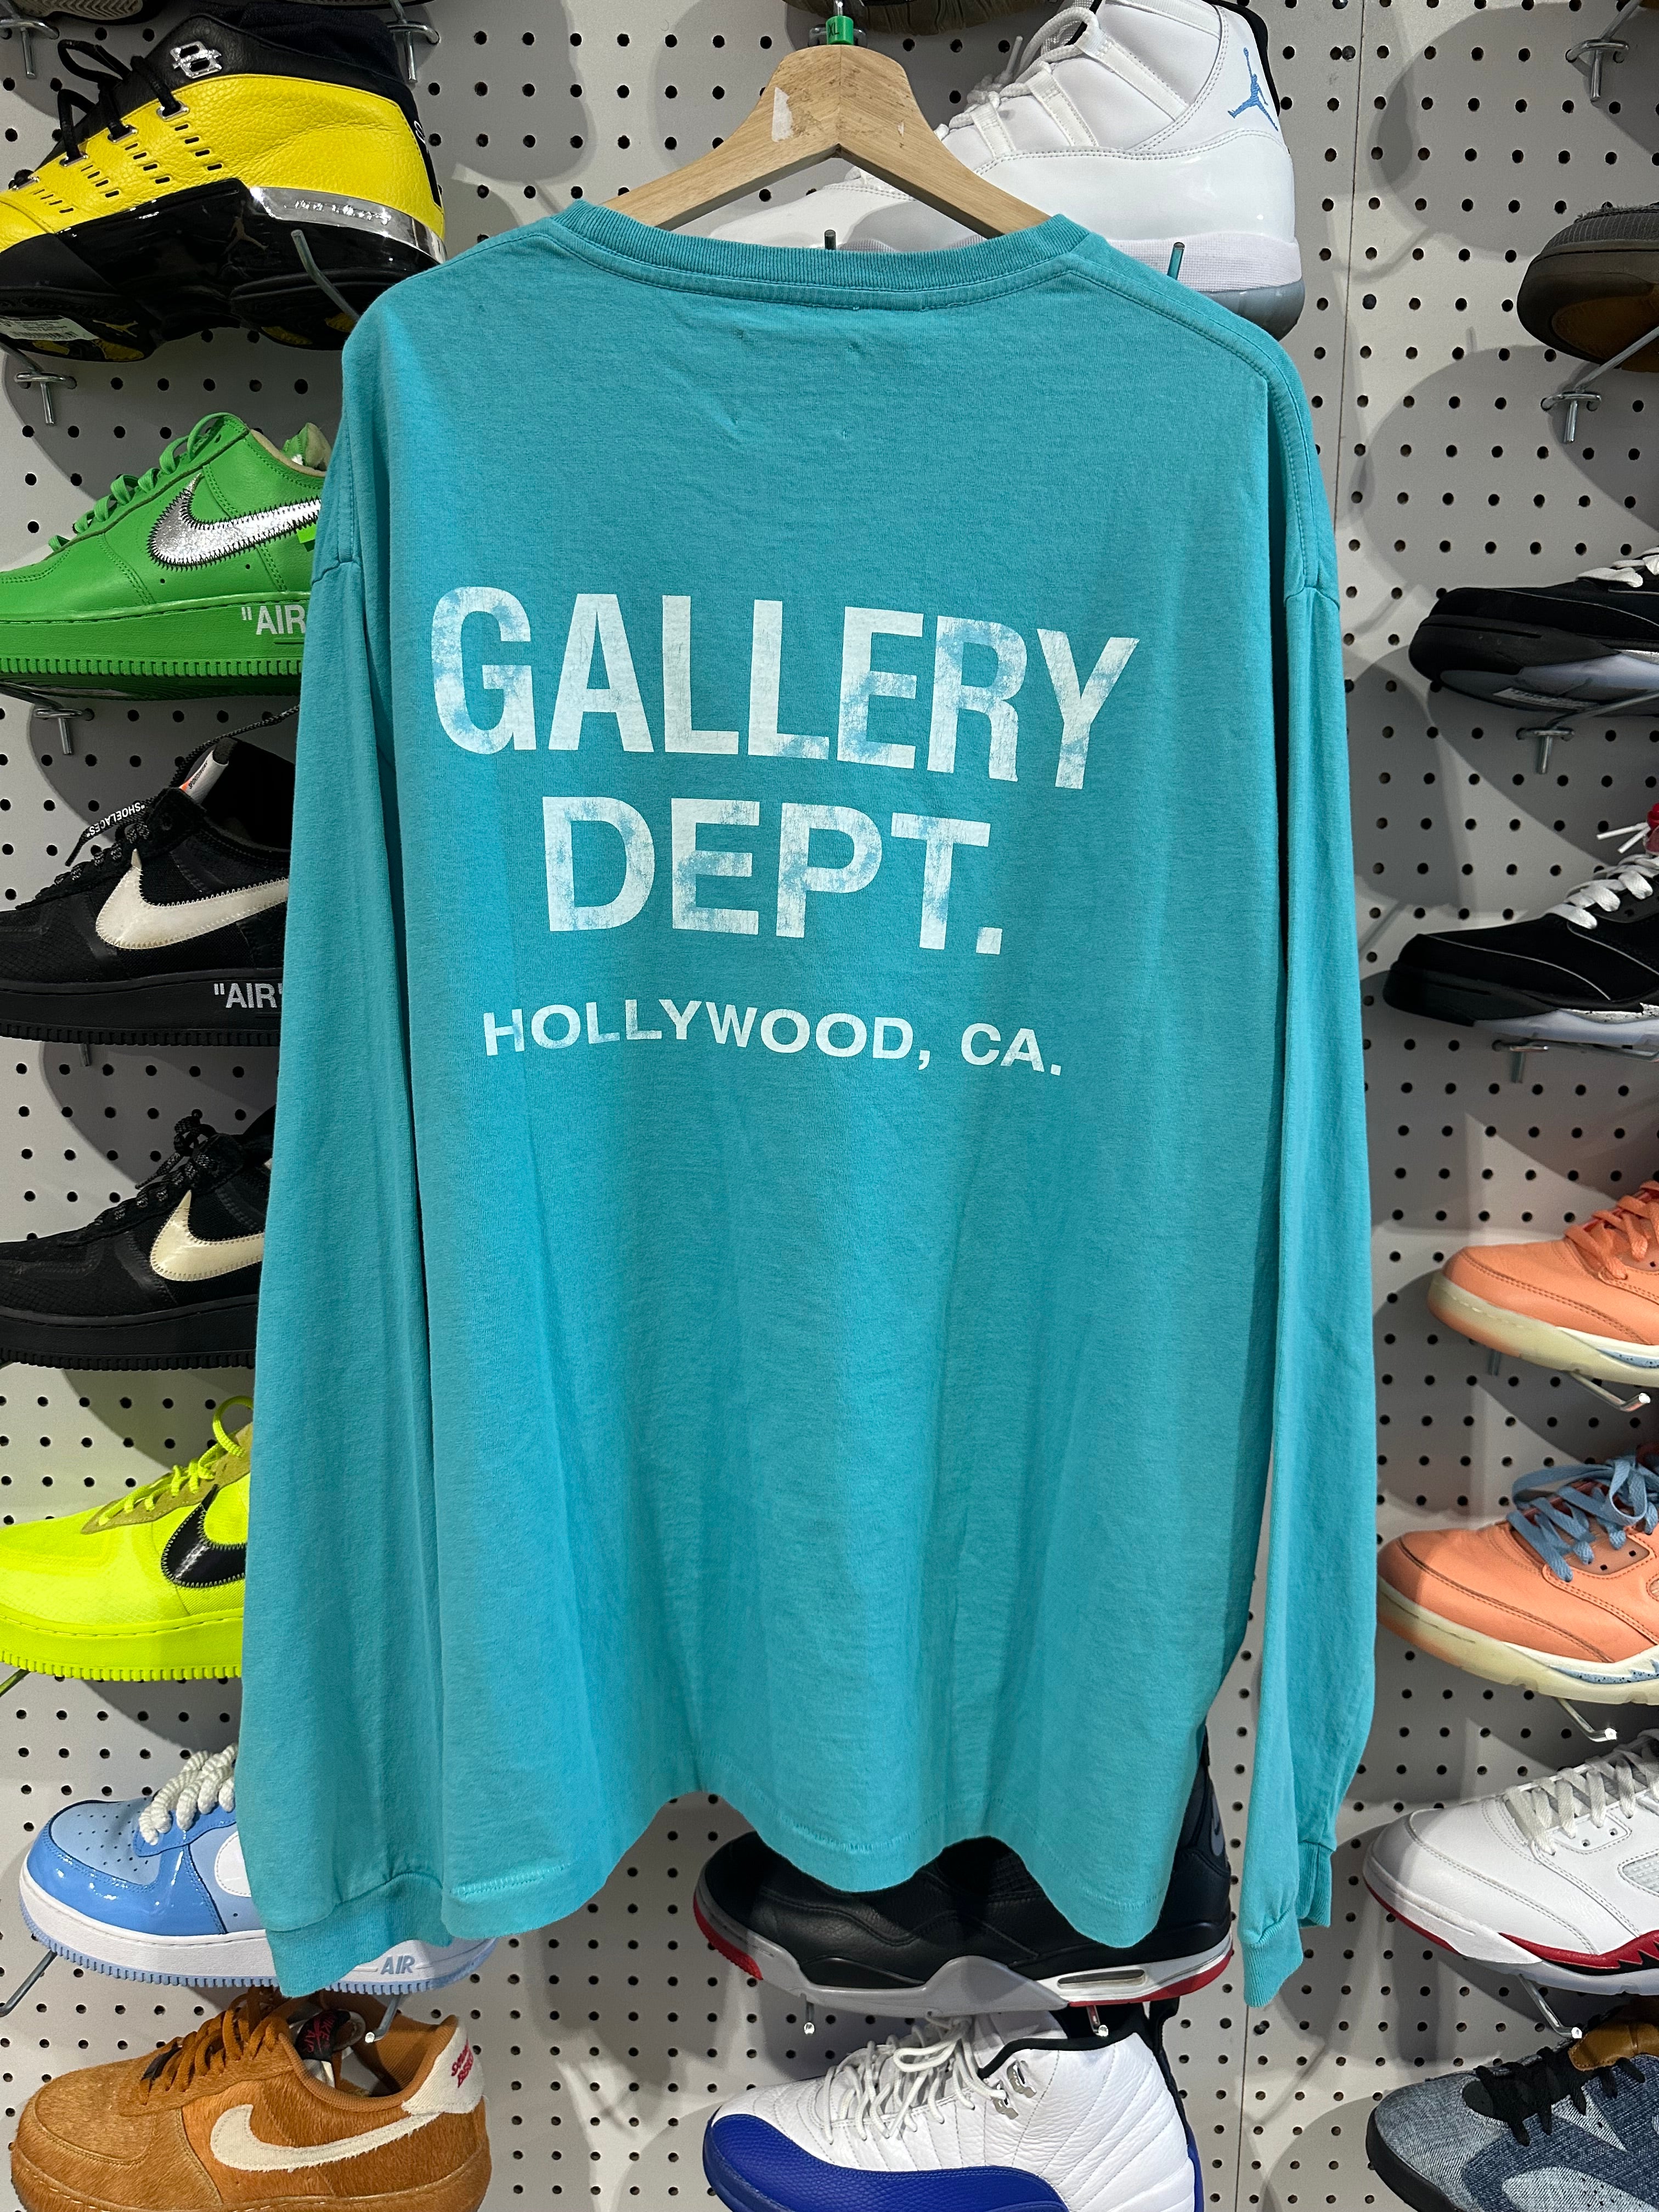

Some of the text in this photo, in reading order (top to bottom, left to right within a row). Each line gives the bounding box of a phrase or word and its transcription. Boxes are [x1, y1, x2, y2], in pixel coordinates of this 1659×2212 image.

[829, 22, 839, 37] XL
[431, 586, 1140, 789] GALLERY
[87, 802, 145, 837] "SHOELACES"
[542, 795, 1003, 956] DEPT.
[483, 998, 1062, 1076] HOLLYWOOD, CA.
[380, 1955, 415, 1975] AIR
